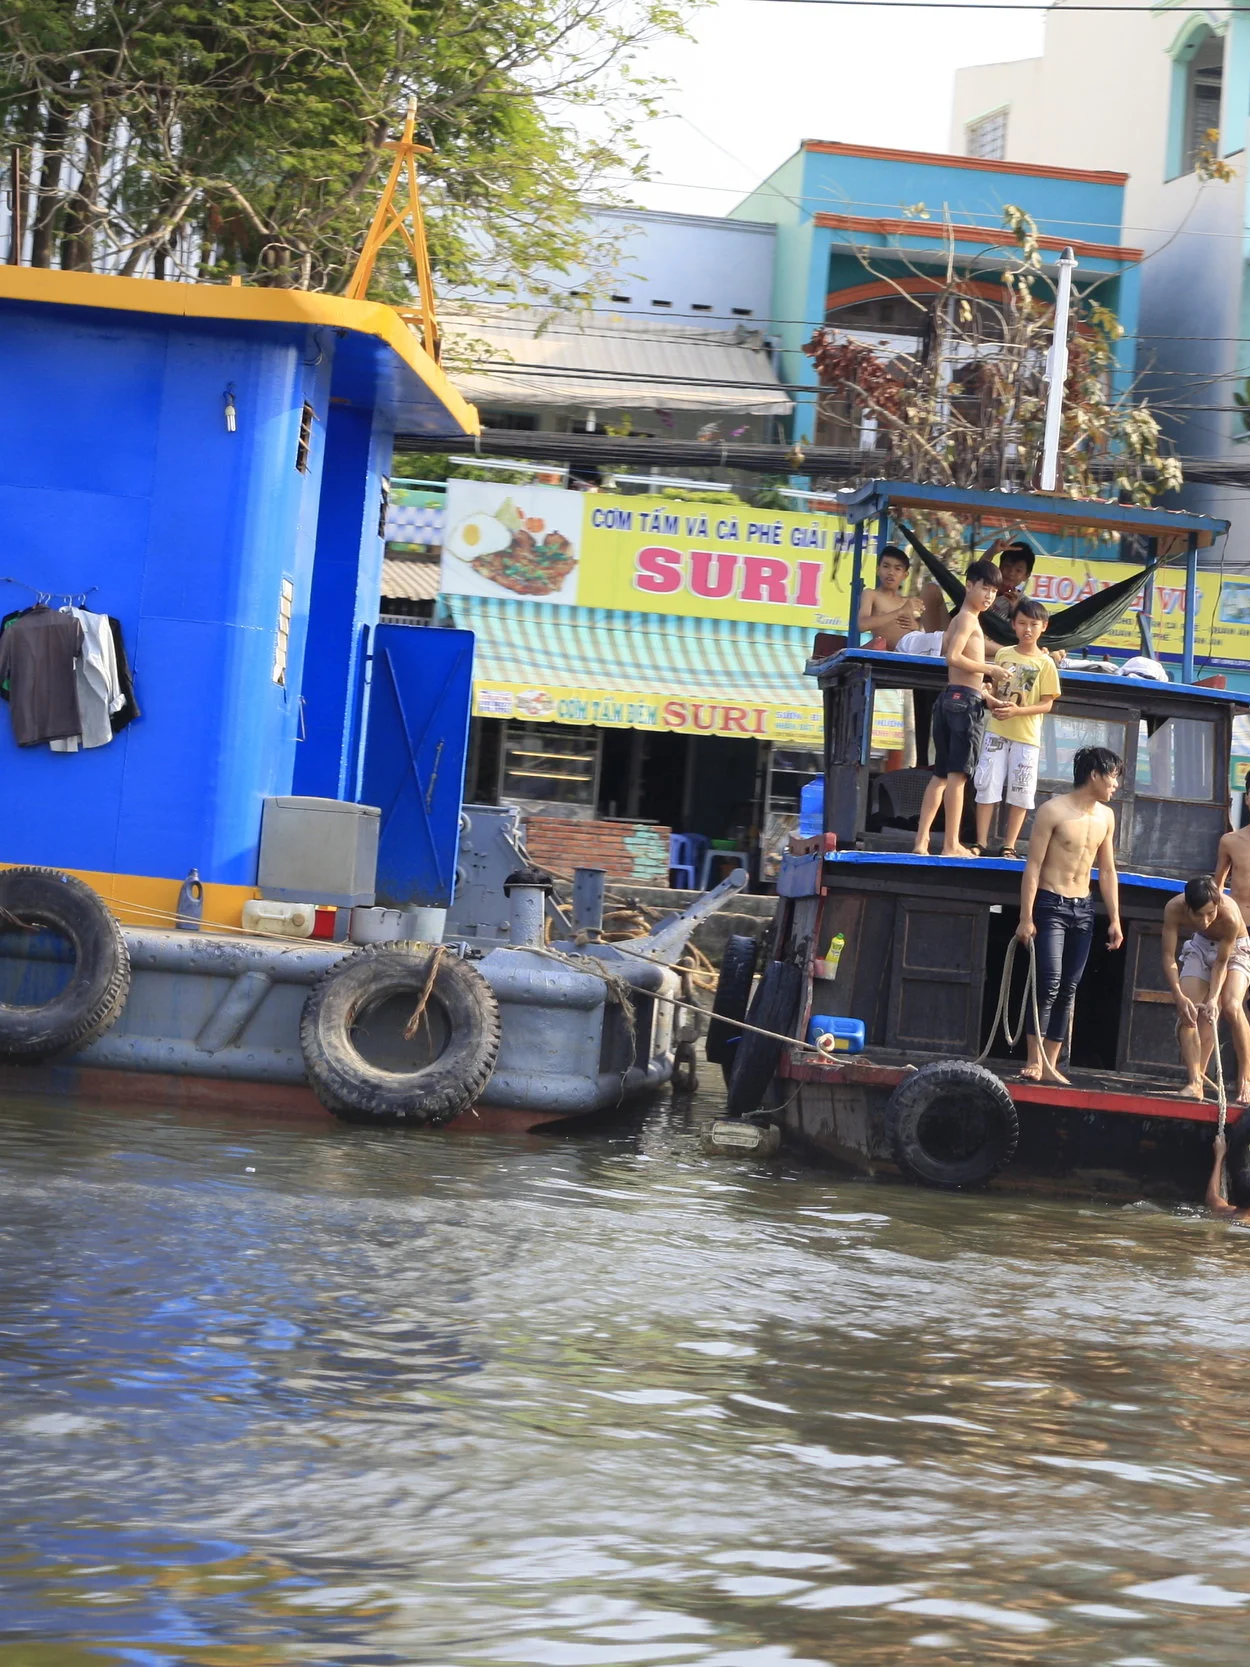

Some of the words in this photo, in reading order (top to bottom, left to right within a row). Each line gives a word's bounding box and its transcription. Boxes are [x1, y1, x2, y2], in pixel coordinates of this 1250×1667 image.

[592, 507, 632, 531] CƠM
[640, 506, 680, 537] TẤM
[685, 513, 709, 538] VÀ
[717, 515, 739, 541] CÀ
[747, 520, 782, 545] PHÊ
[790, 522, 826, 550] GIẢI
[634, 546, 824, 607] SURI
[663, 700, 768, 734] SURI
